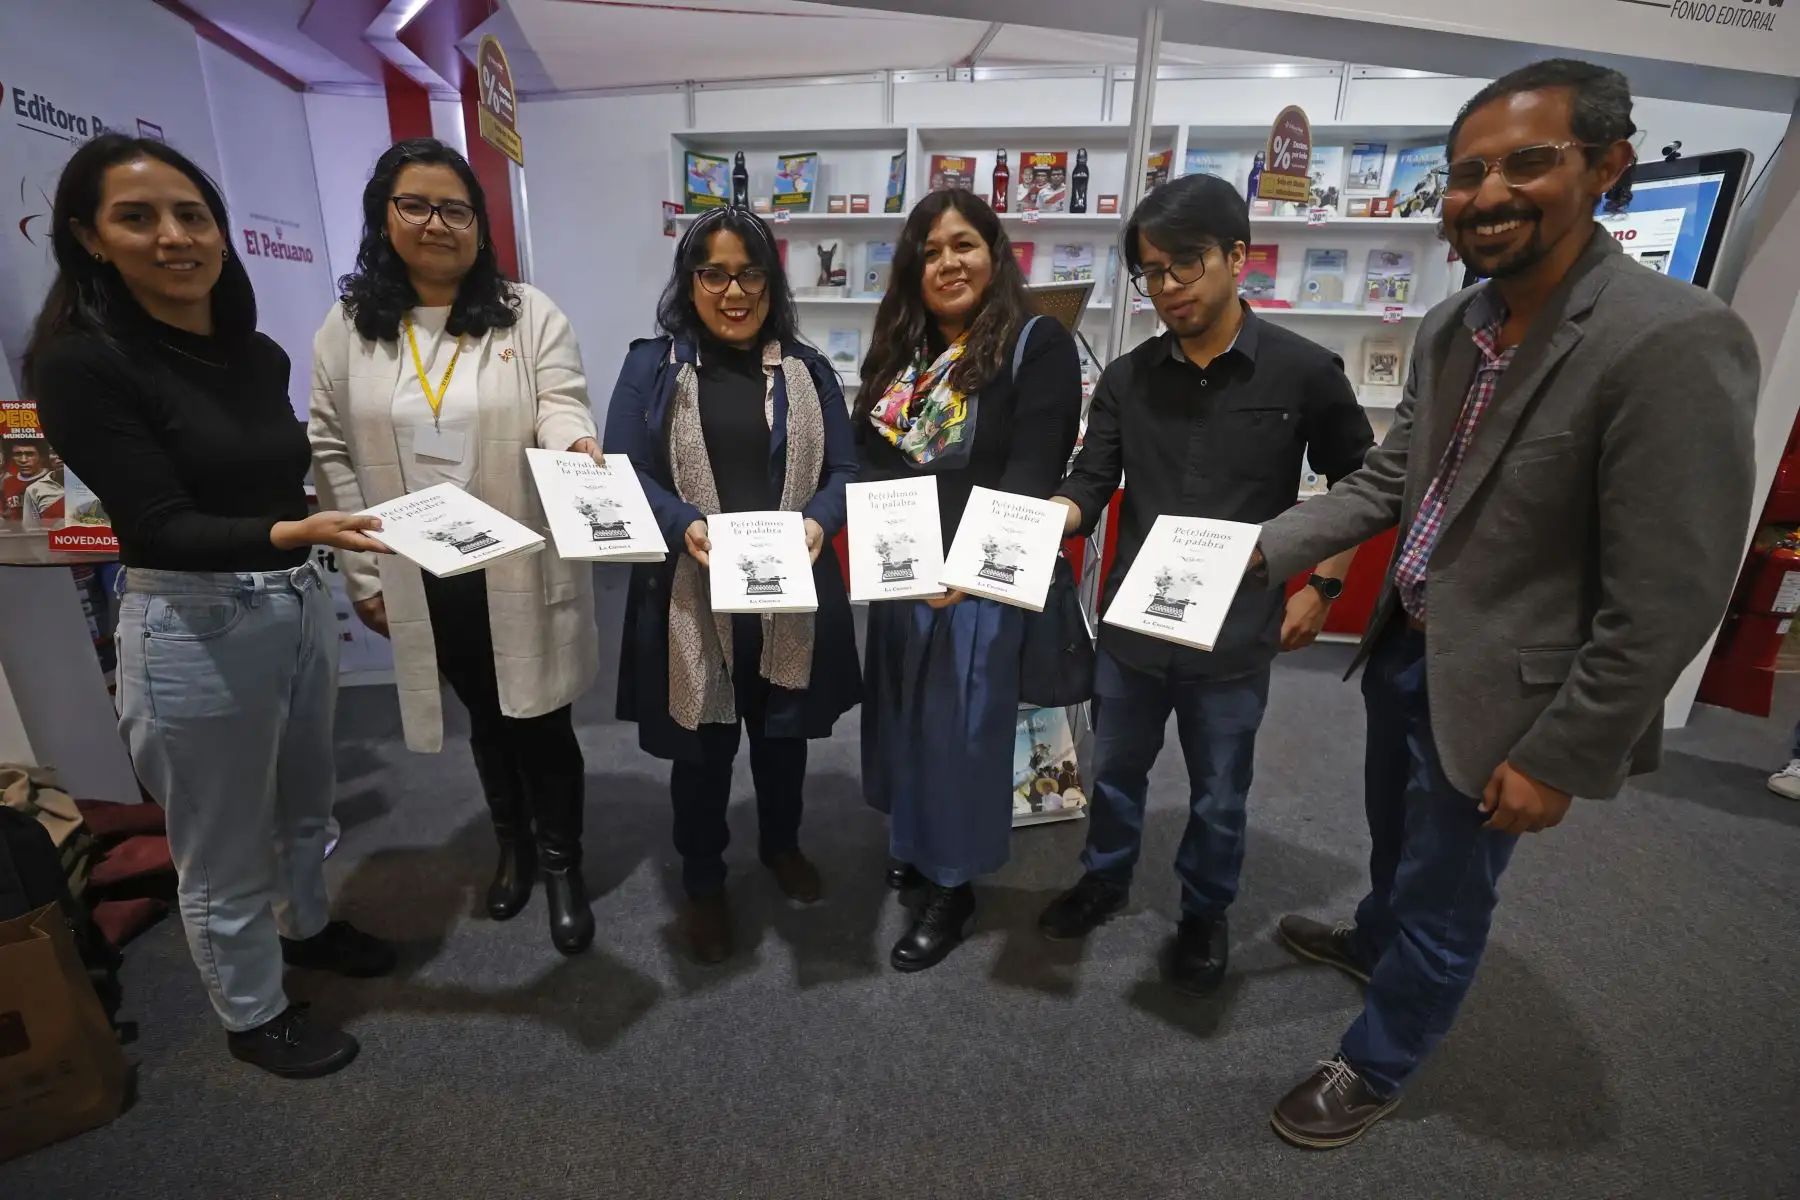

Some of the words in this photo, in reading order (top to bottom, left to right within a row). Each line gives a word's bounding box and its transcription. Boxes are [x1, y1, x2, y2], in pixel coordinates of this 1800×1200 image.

[1670, 0, 1716, 23] FONDO
[1715, 6, 1776, 31] EDITORIAL
[12, 87, 88, 136] Editora
[243, 229, 260, 256] El
[261, 233, 313, 263] Peruano
[0, 410, 40, 428] ER
[882, 498, 916, 510] palabra
[746, 527, 782, 535] palabra
[1174, 527, 1232, 540] Pe(r)dimos
[54, 535, 119, 545] NOVEDADE
[1172, 535, 1181, 543] la
[1184, 537, 1224, 550] palabra
